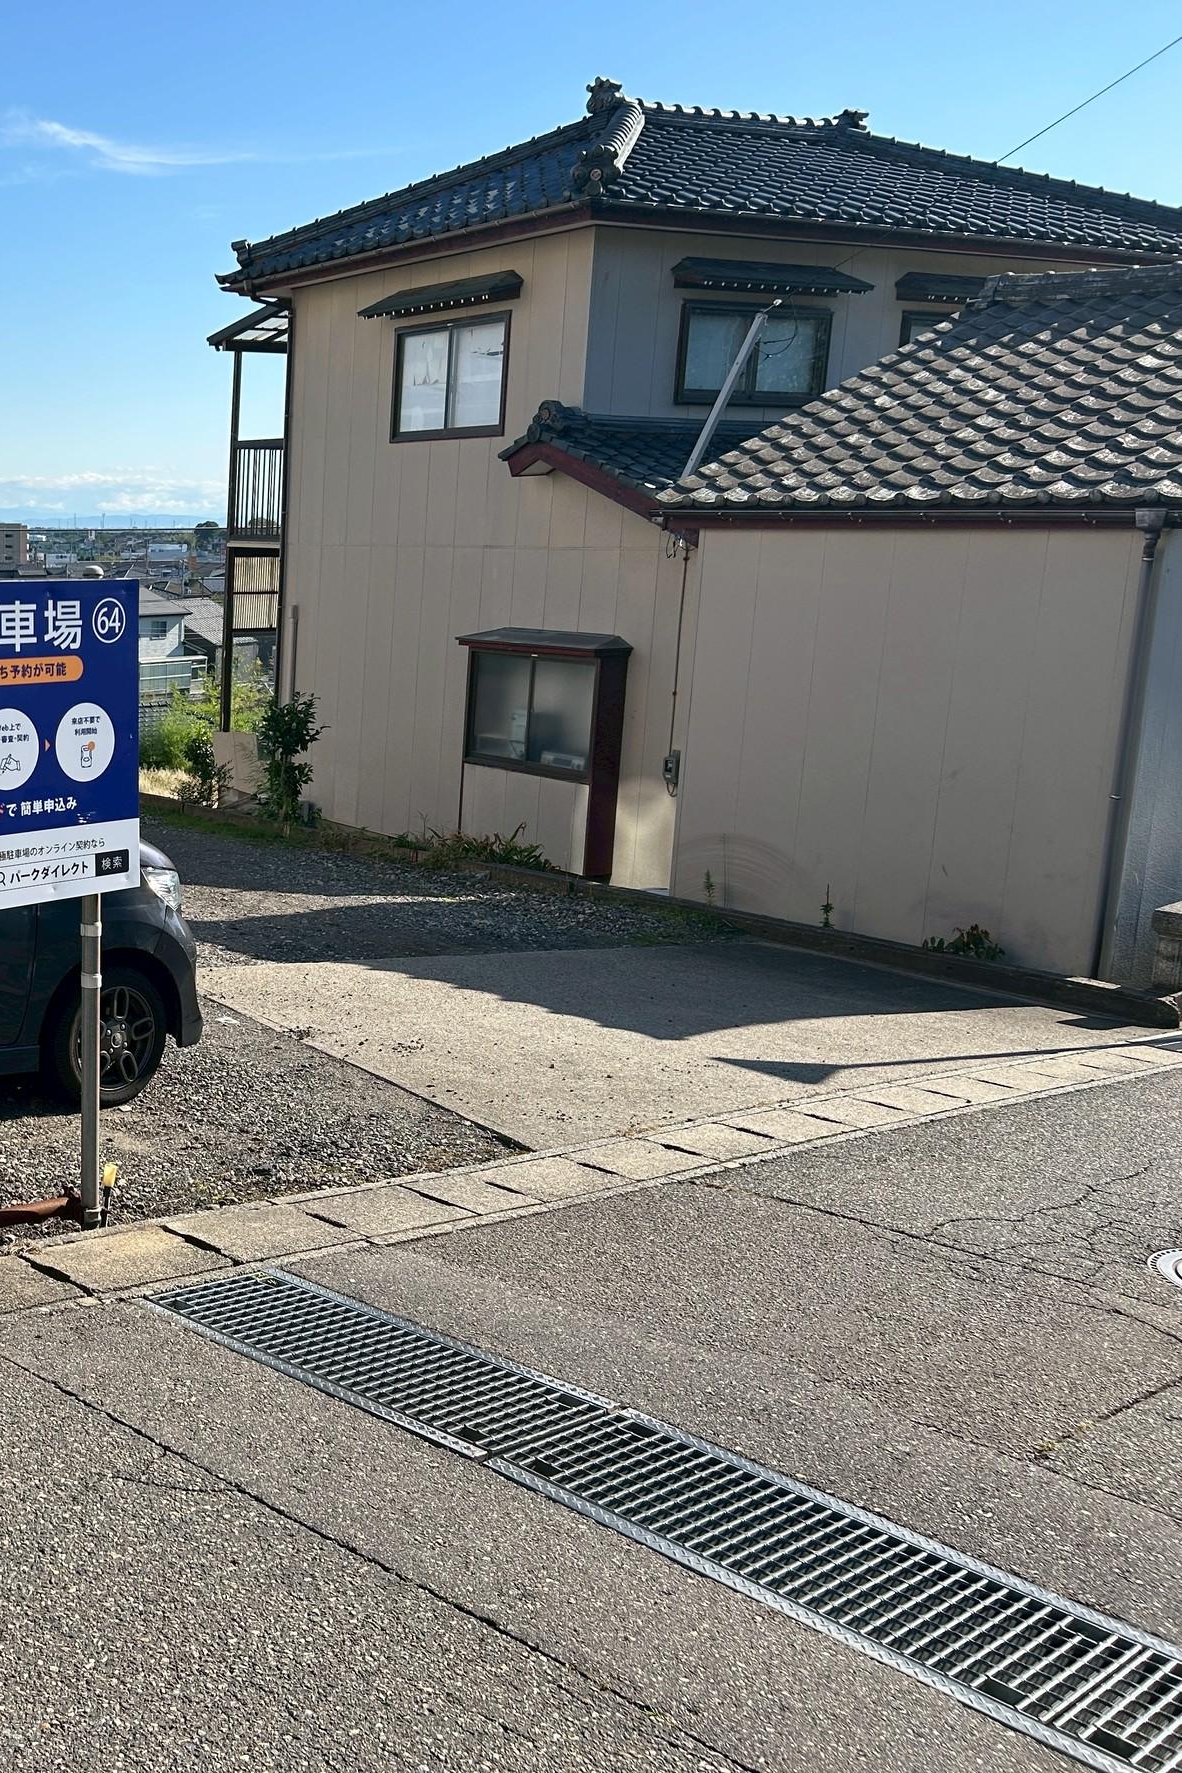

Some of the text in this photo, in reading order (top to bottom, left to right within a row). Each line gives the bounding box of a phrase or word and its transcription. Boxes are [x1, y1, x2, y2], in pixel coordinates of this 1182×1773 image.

[9, 860, 89, 884] パークダイレクト
[100, 855, 123, 871] 検索
